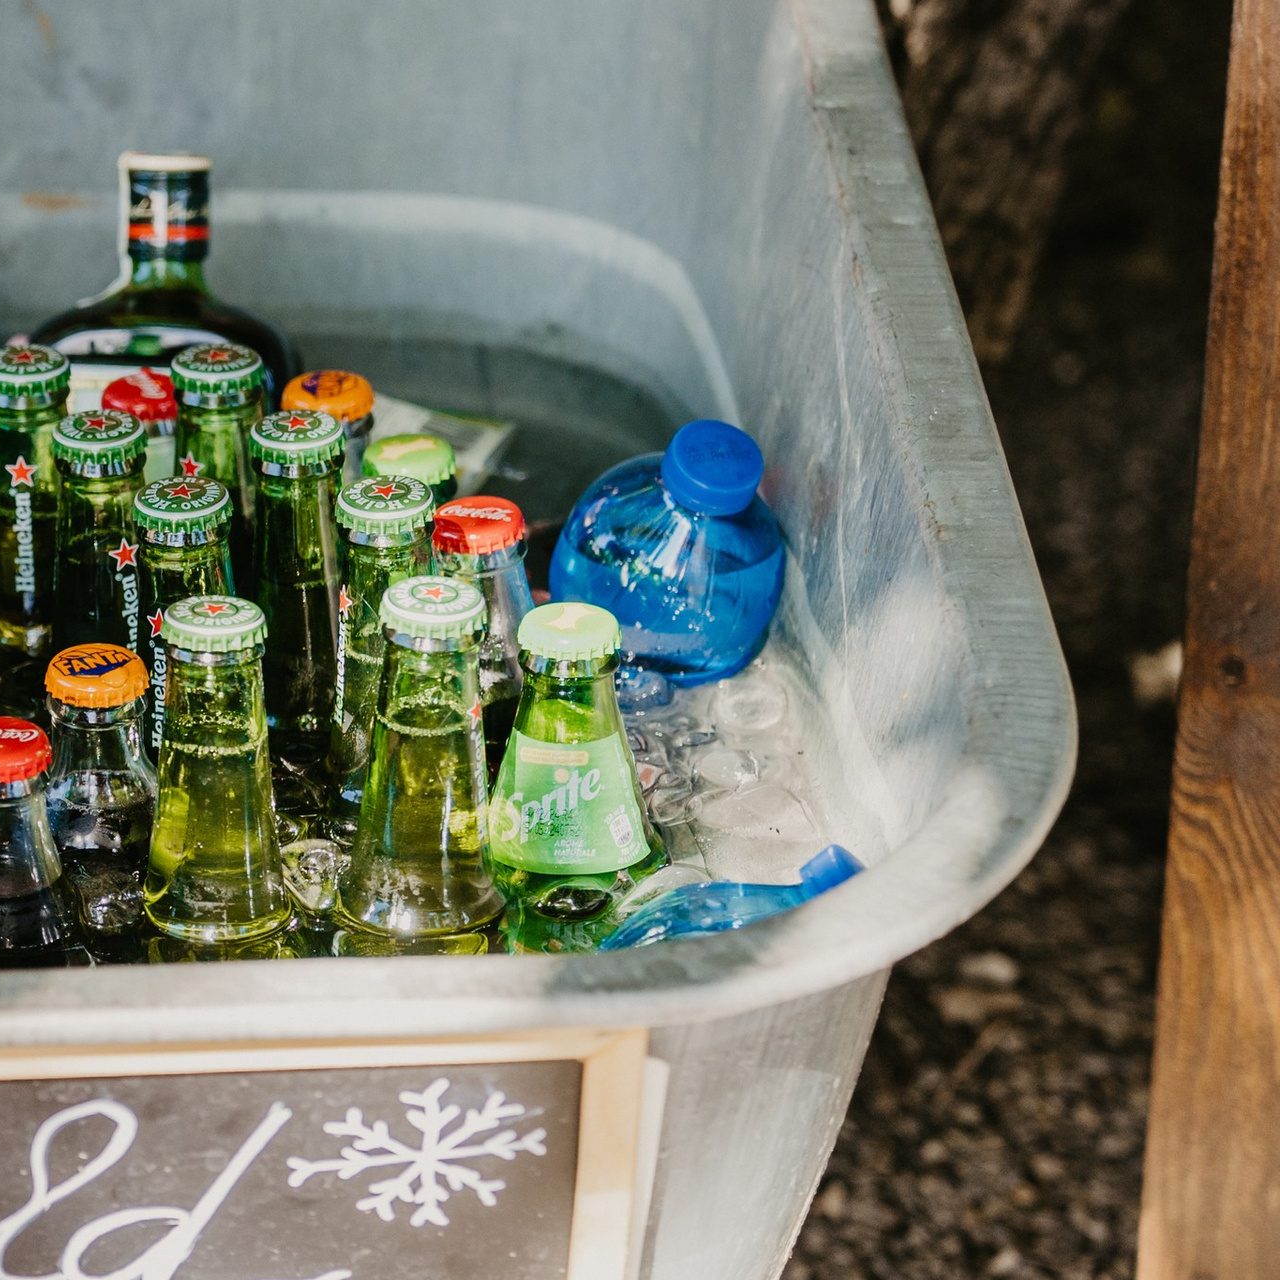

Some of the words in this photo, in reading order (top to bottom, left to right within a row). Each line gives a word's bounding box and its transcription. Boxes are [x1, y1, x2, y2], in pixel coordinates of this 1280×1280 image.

[11, 492, 36, 593] Heineken
[52, 650, 132, 677] FANTA
[151, 646, 169, 749] Heineken
[501, 768, 601, 845] Sprite
